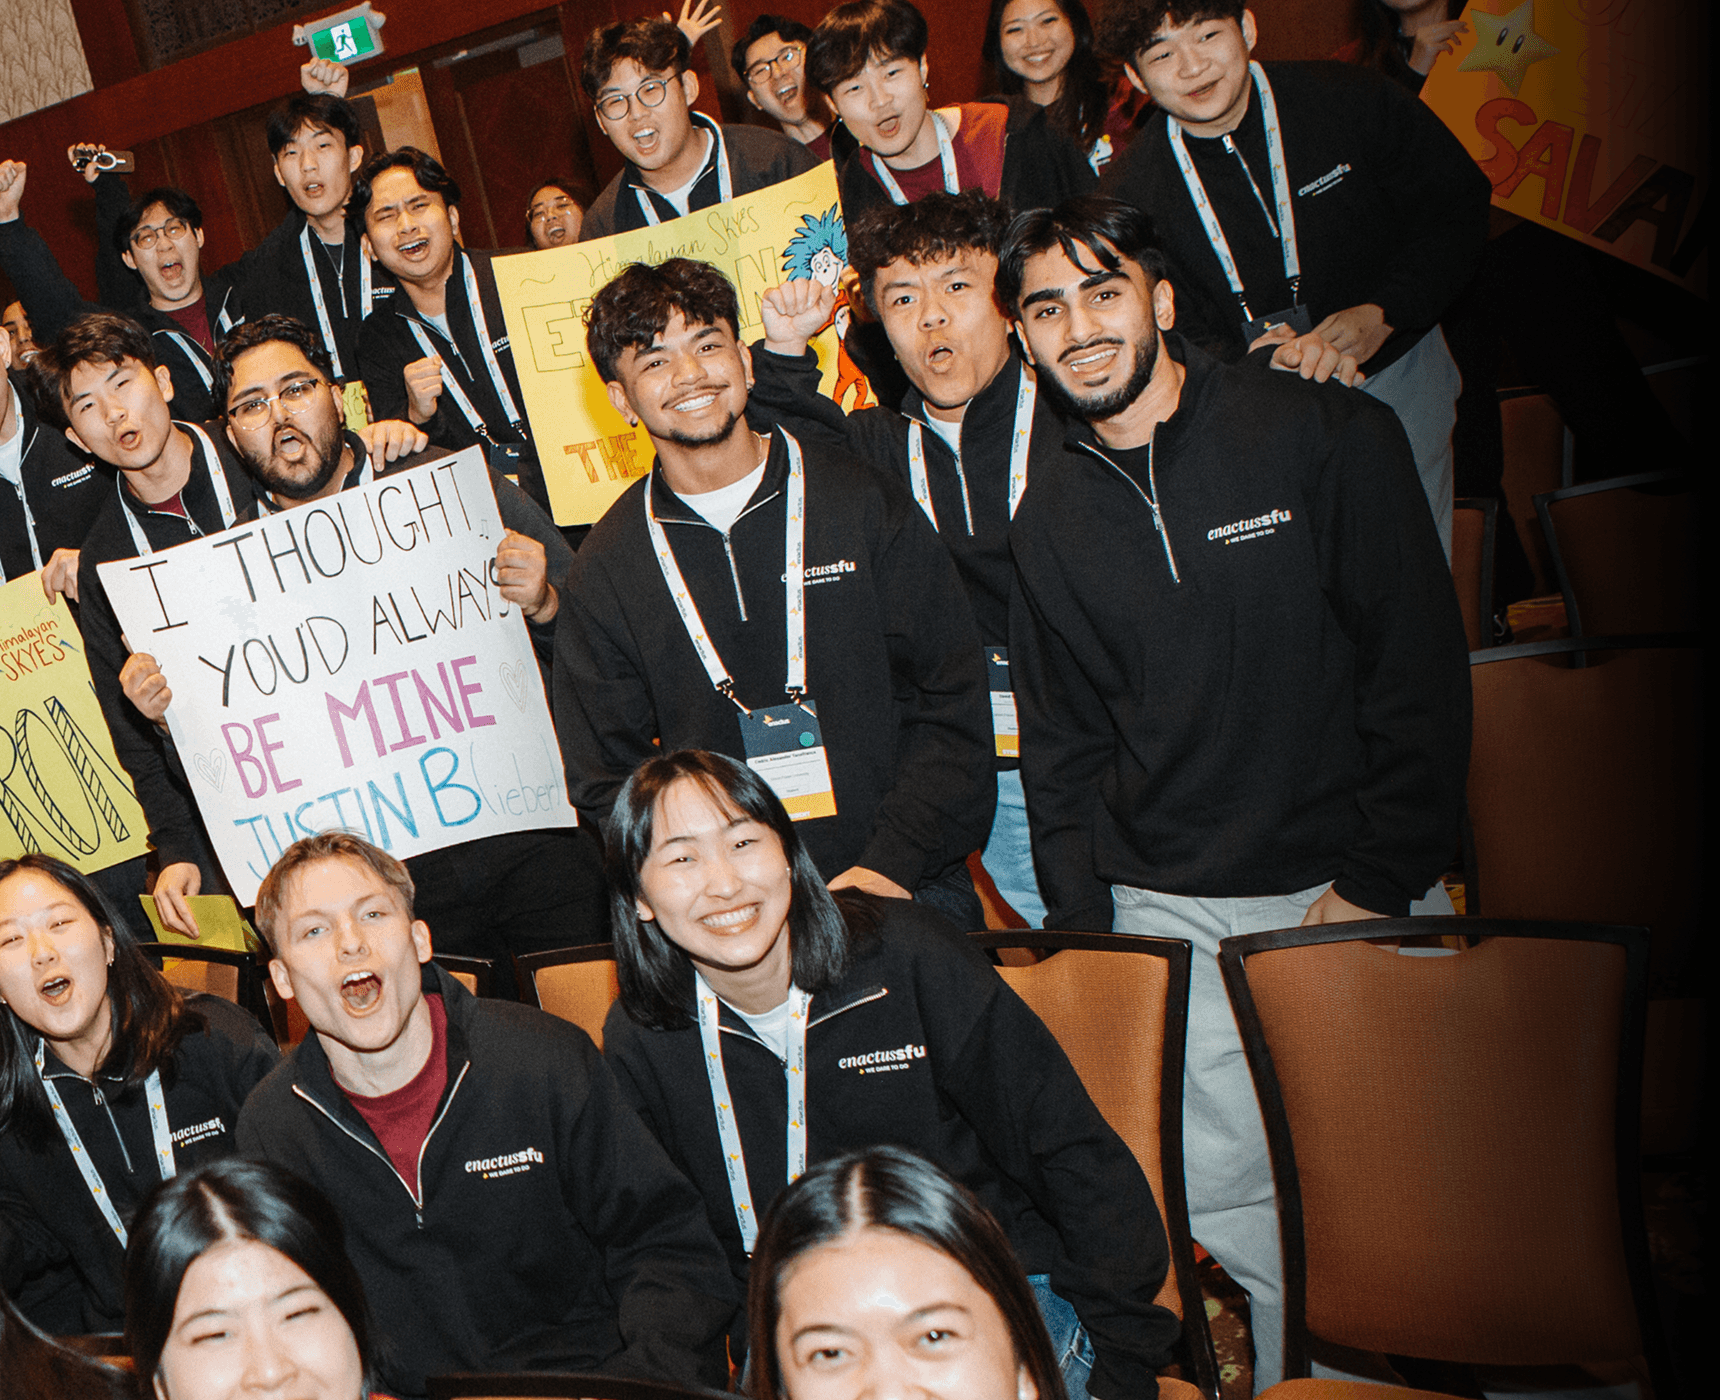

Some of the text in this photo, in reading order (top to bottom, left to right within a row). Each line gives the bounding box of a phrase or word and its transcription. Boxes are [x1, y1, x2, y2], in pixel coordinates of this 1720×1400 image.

[1475, 97, 1700, 278] SAVA
[563, 431, 650, 484] THE
[130, 461, 472, 633] I THOUGHT
[780, 559, 857, 583] ectussfu
[0, 634, 66, 682] SKYES
[221, 655, 497, 799] BE MINE
